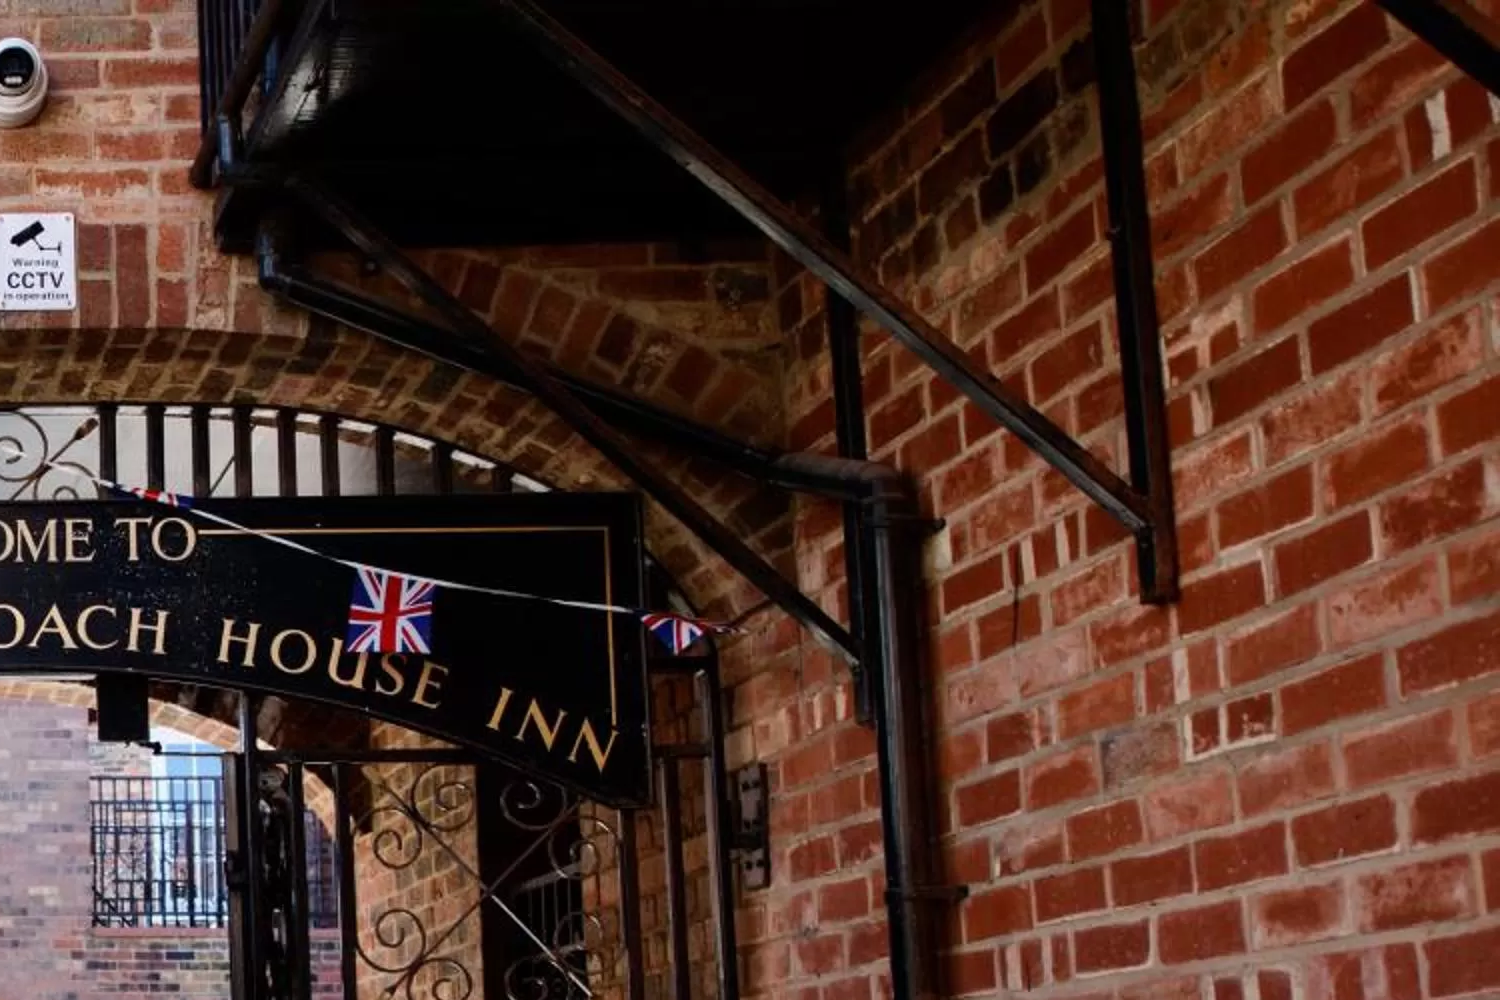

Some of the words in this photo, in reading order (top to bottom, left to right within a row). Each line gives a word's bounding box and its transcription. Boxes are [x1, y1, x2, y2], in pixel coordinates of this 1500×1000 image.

[11, 257, 59, 269] Warning
[7, 271, 64, 289] CCTV
[4, 291, 14, 300] in
[17, 291, 69, 301] operation
[115, 515, 198, 563] TO
[217, 616, 450, 710] HOUSE
[485, 686, 621, 774] INN
